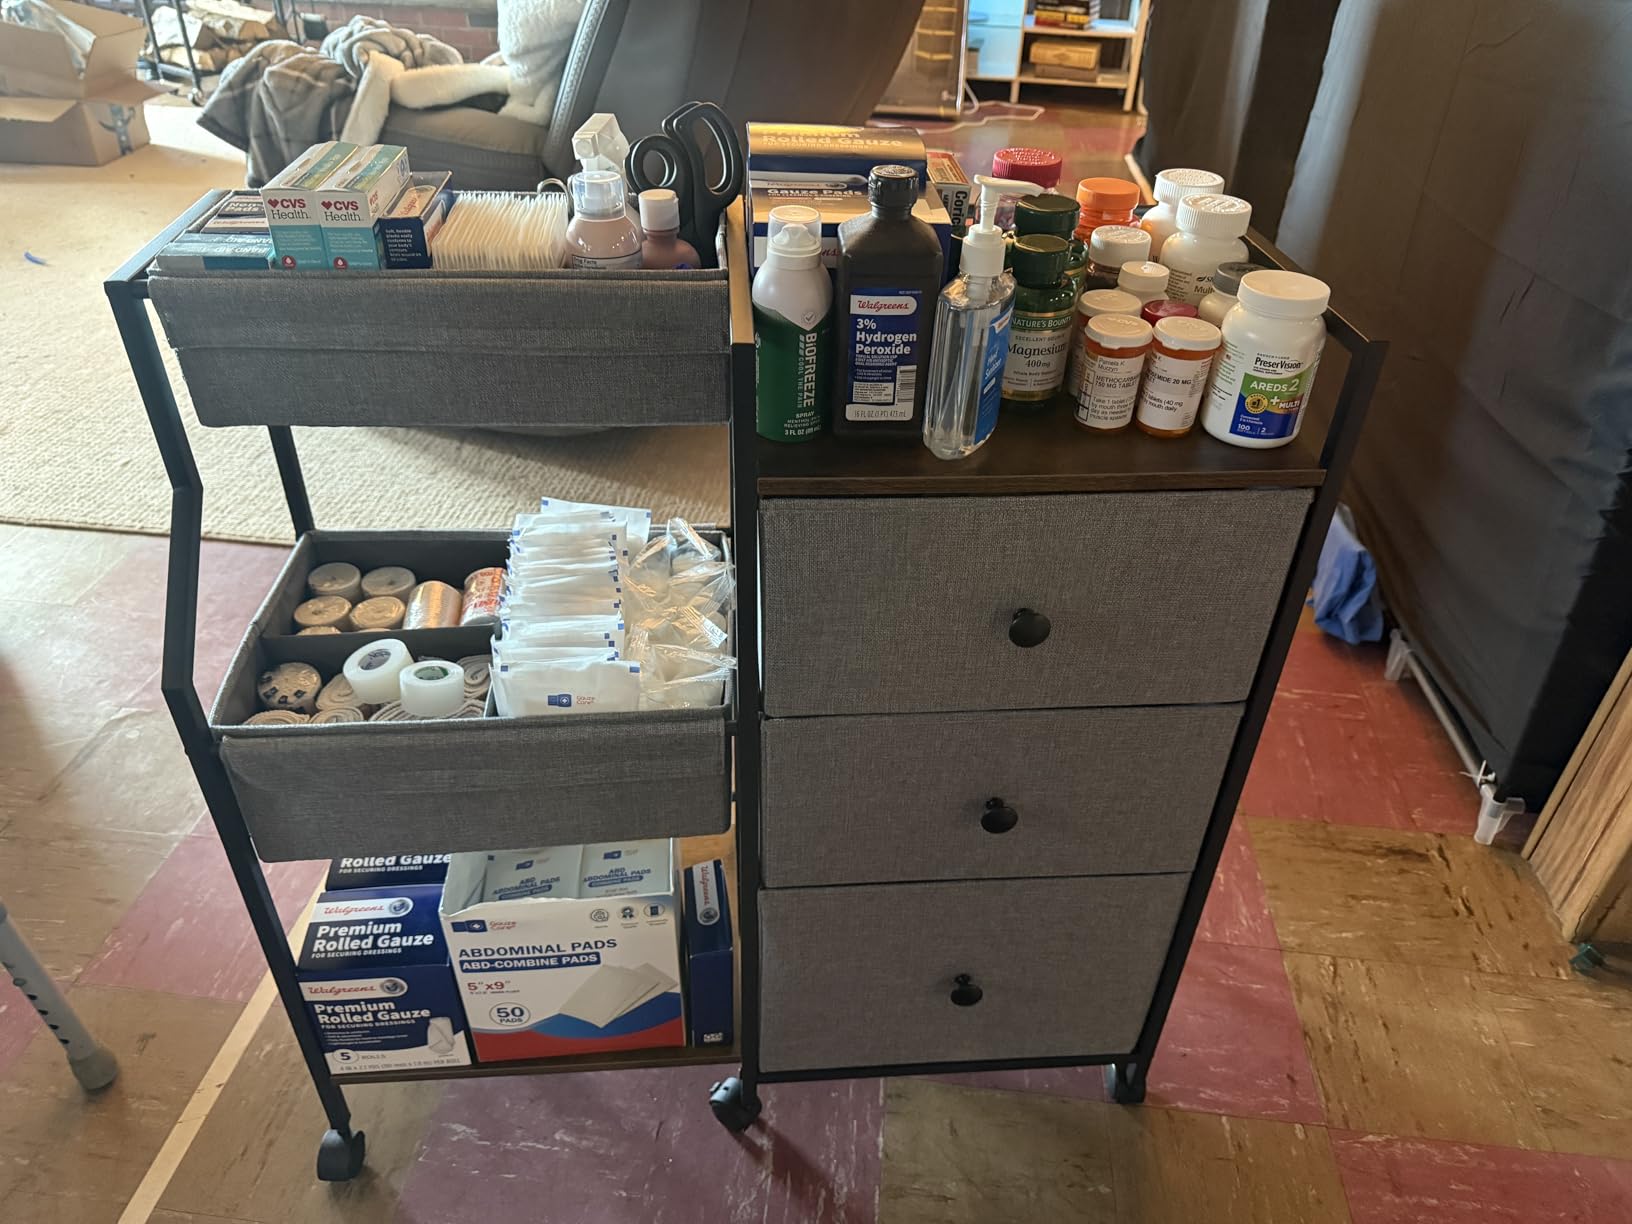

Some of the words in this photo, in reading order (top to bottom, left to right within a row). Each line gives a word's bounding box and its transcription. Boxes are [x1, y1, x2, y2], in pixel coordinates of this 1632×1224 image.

[763, 136, 832, 144] Rolled
[838, 139, 903, 147] Gauze
[281, 199, 307, 209] CVS
[334, 201, 359, 211] CVS
[952, 191, 969, 225] Coric
[272, 210, 309, 220] Health
[325, 212, 361, 222] Health
[859, 301, 910, 312] Walgreens
[857, 319, 877, 330] 3%
[1013, 318, 1047, 328] NATURE'S
[857, 332, 917, 345] Hydrogen
[856, 344, 912, 355] Peroxide
[1255, 357, 1301, 370] PreserVision
[1250, 381, 1288, 392] AREDS
[1289, 379, 1300, 392] 2
[1164, 405, 1178, 413] daily
[1279, 401, 1301, 409] MULTI
[796, 411, 815, 419] SPRAY
[1237, 423, 1251, 431] 100
[341, 855, 397, 868] Rolled
[401, 854, 453, 866] Gauze
[352, 866, 386, 874] SECURING
[630, 868, 652, 876] PADS
[324, 905, 386, 916] Walgreens
[317, 921, 403, 938] Premium
[313, 936, 374, 953] Rolled
[378, 933, 435, 948] Gauze
[327, 950, 362, 958] SECURING
[364, 948, 402, 956] DRESSINGS
[459, 944, 566, 959] ABDOMINAL
[571, 939, 618, 952] PADS
[462, 956, 559, 971] ABD-COMBINE
[562, 954, 598, 965] PADS
[309, 986, 377, 996] Walgreens
[315, 1001, 396, 1015] Premium
[496, 1007, 525, 1018] 50
[318, 1013, 375, 1025] Rolled
[378, 1009, 432, 1021] Gauze
[341, 1052, 351, 1061] 5
